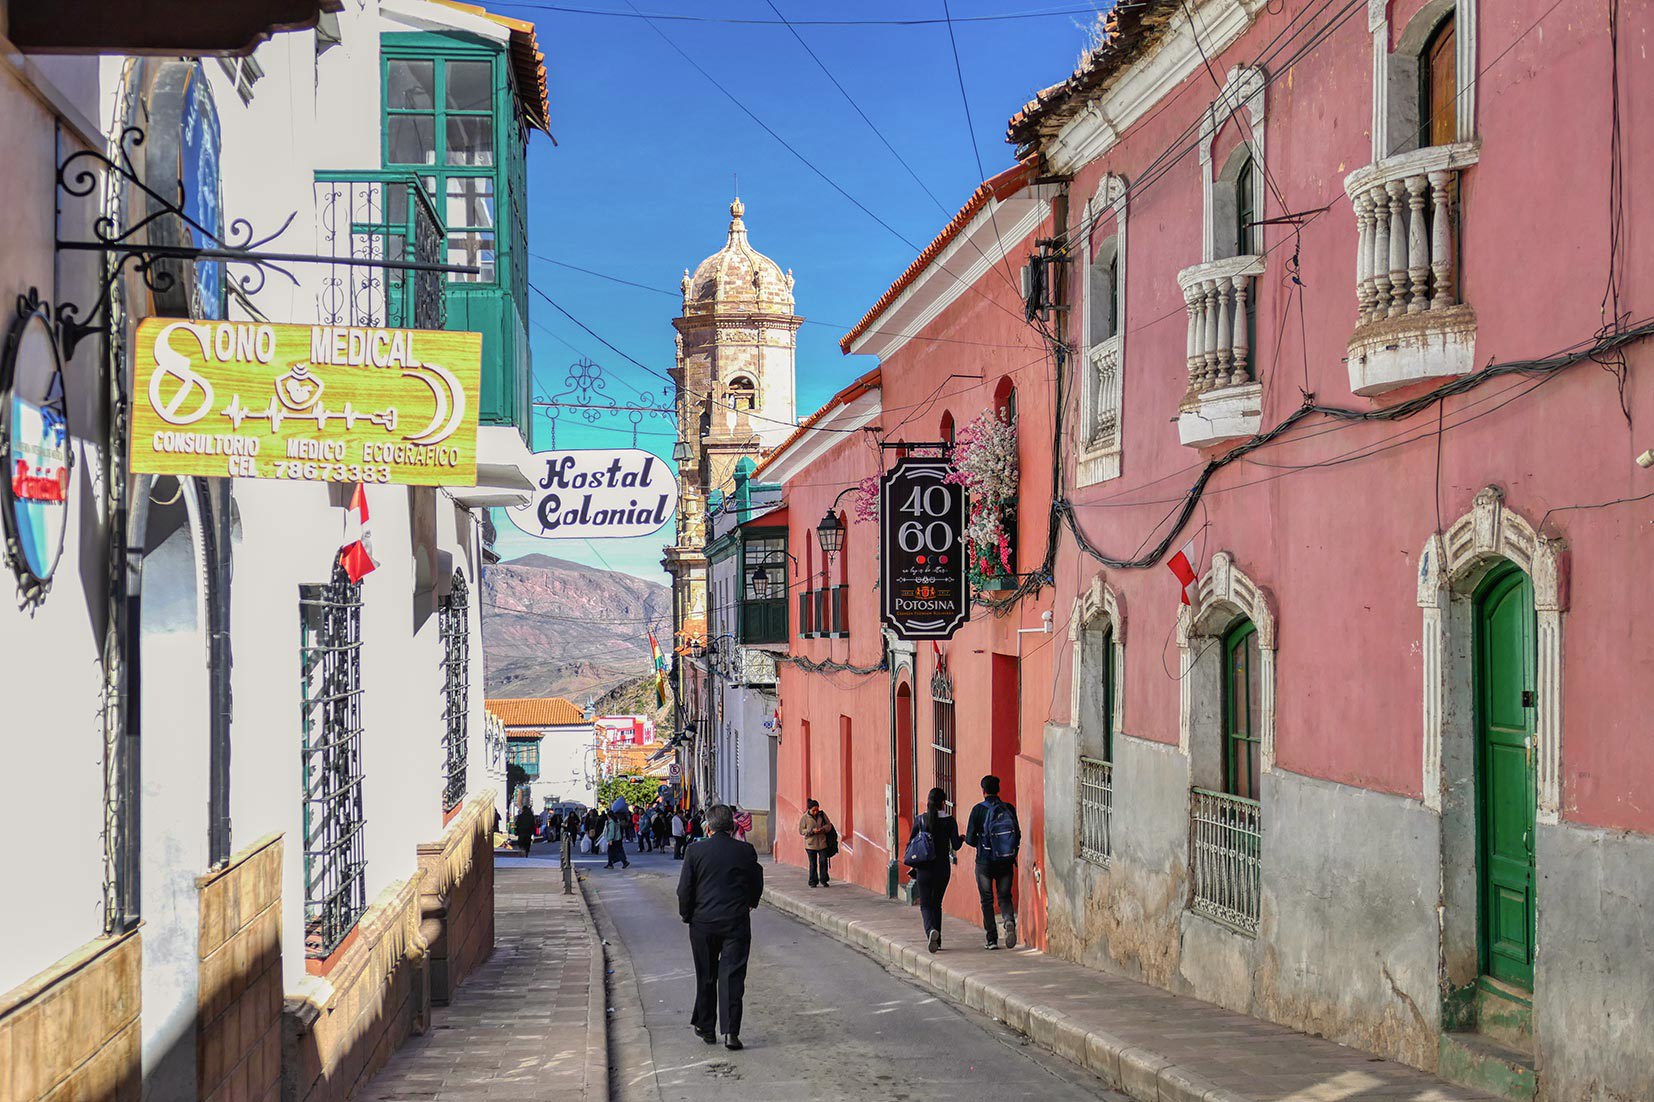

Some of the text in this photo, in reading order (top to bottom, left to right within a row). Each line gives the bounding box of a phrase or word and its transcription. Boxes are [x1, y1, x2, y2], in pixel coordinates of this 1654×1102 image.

[311, 326, 420, 368] MEDICAL
[153, 431, 458, 467] CONSULTORIO MEDICO ECOGRAFICO
[273, 461, 392, 483] 78673383
[539, 456, 654, 490] Hostal
[537, 494, 669, 535] Colonial
[900, 485, 952, 517] 40
[898, 521, 953, 553] 60
[895, 598, 955, 611] POTOSINA
